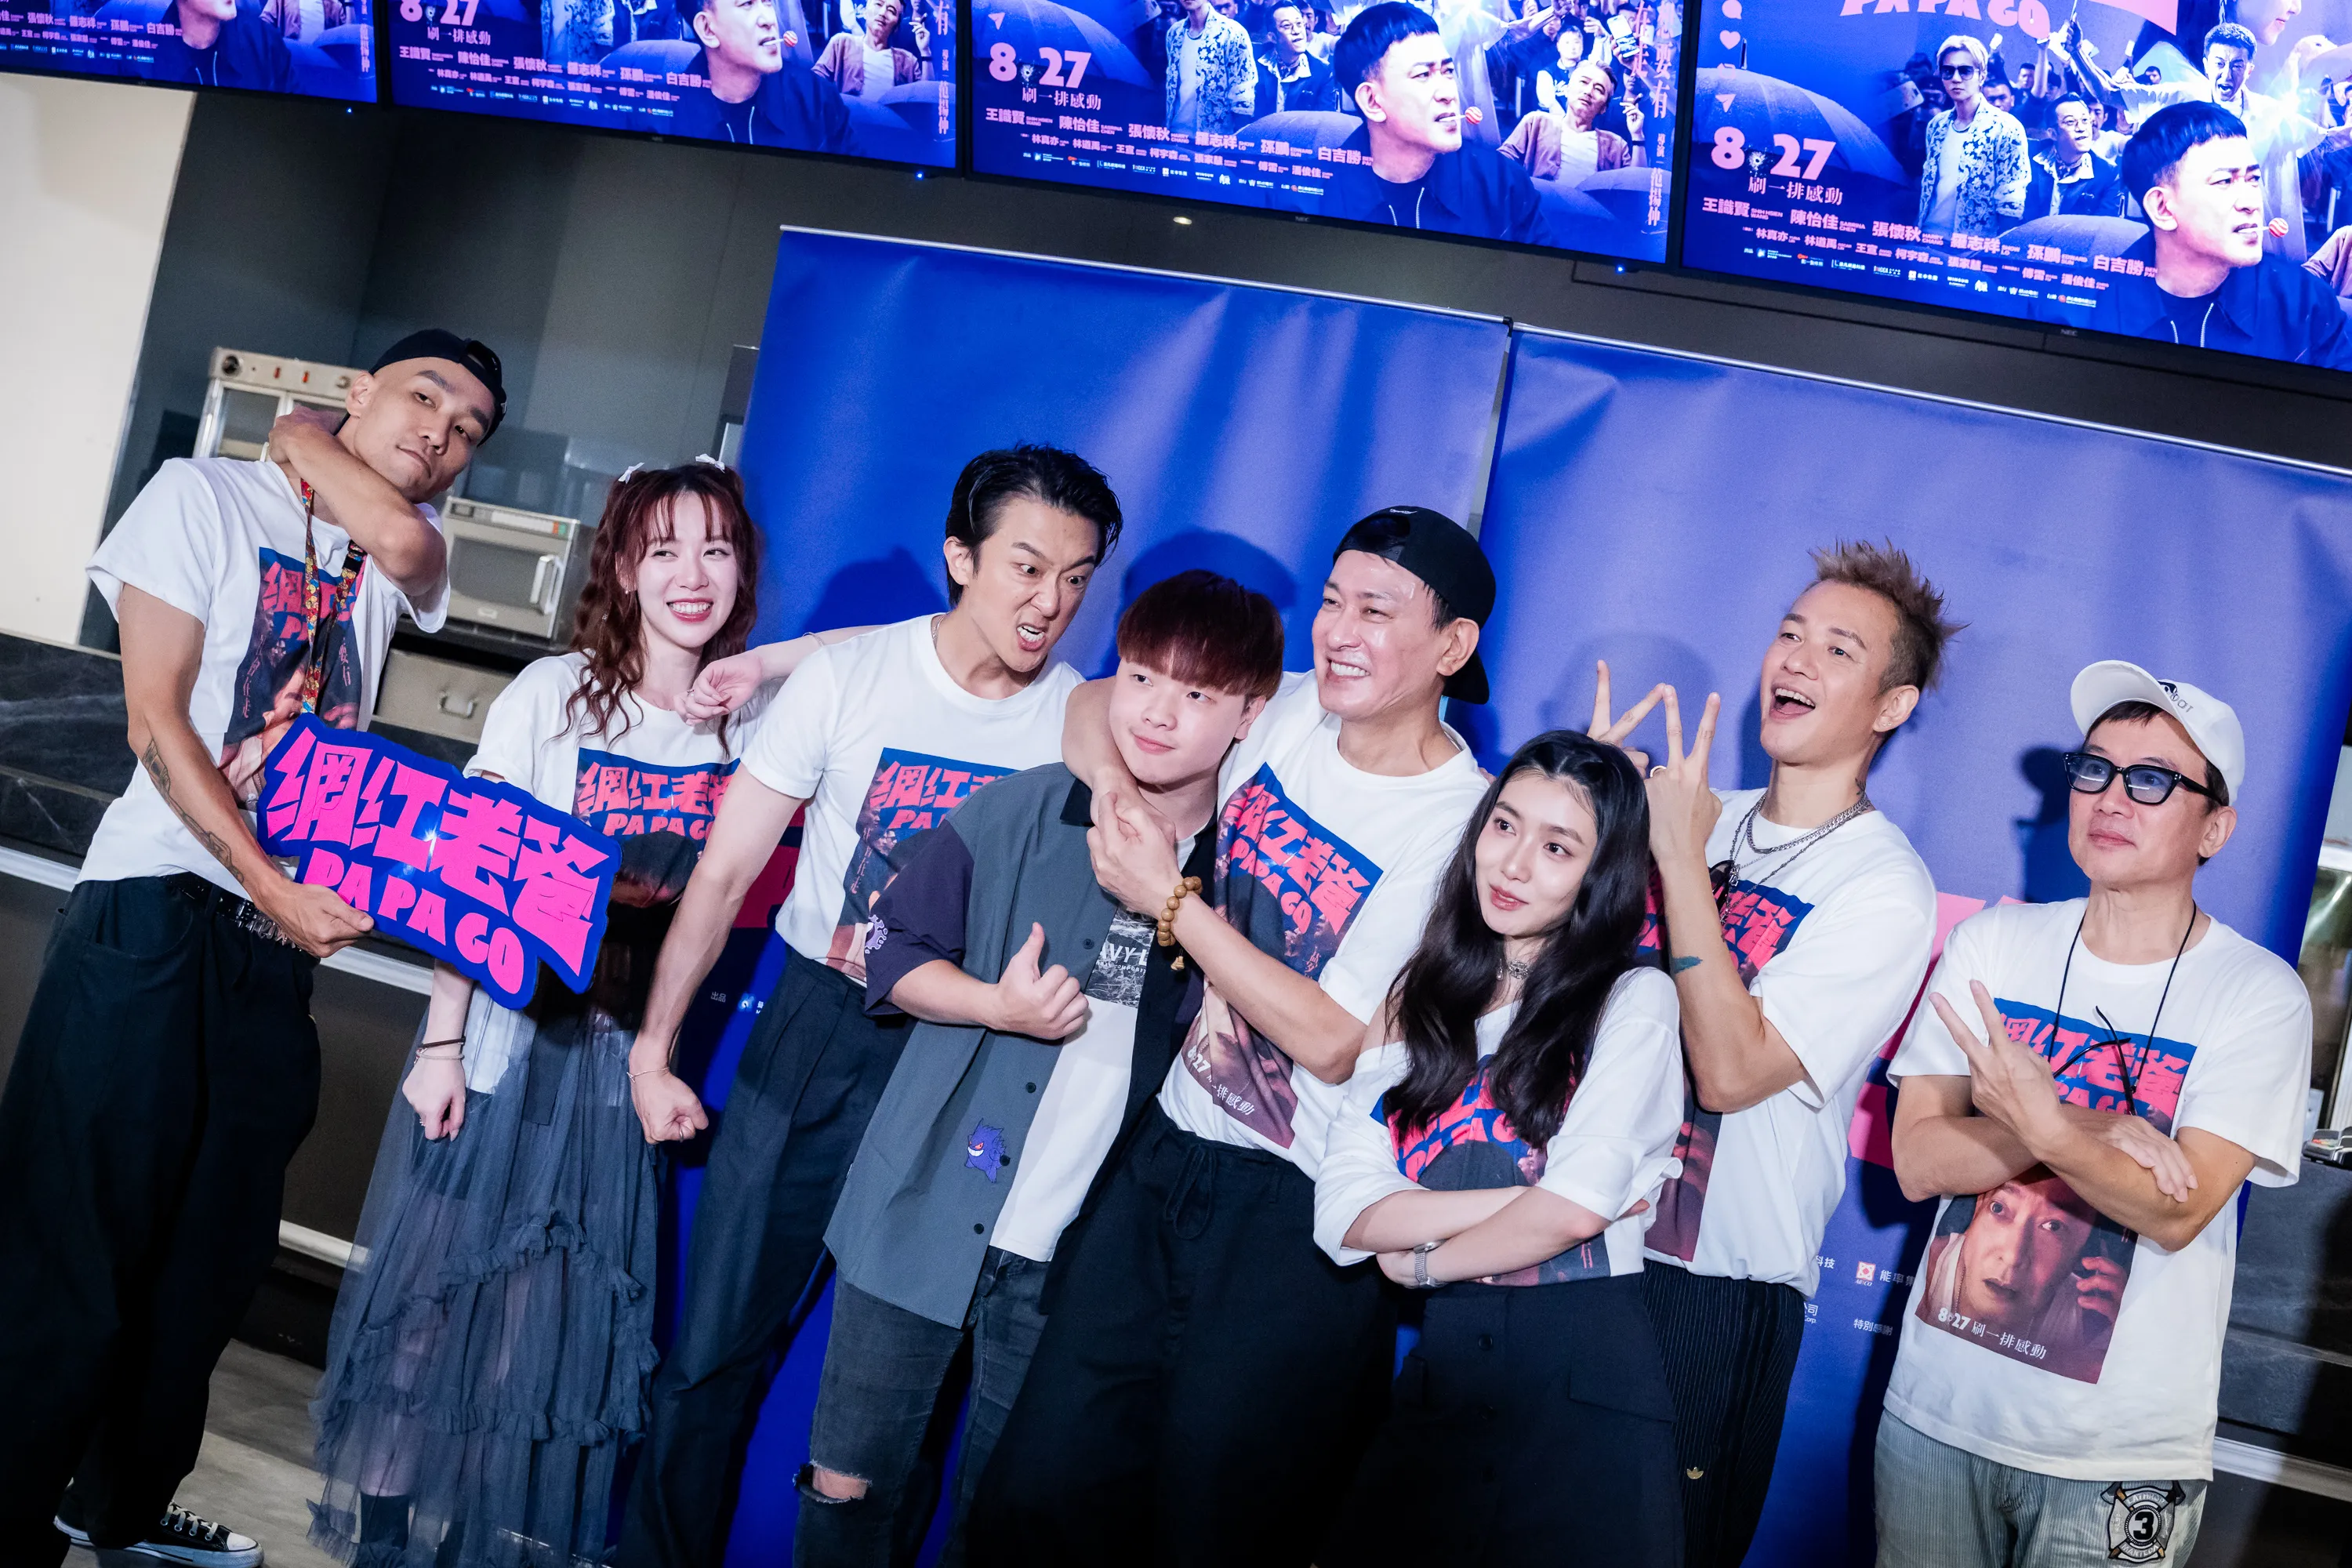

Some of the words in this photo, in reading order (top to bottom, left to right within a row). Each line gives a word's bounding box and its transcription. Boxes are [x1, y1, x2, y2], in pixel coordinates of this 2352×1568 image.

[1039, 47, 1091, 89] 27
[1022, 88, 1102, 111] 刷一排感動
[1059, 115, 1100, 133] 陳怡佳
[1128, 123, 1170, 141] 張懷秋
[1318, 146, 1361, 165] 白吉勝
[1770, 133, 1836, 180] 27
[1748, 176, 1843, 205] 刷一排感動
[1702, 197, 1750, 217] 王識賢
[1790, 209, 1838, 230] 陳怡佳
[1872, 220, 1922, 242] 張懷秋
[1950, 232, 2000, 254] 羅志祥
[2027, 244, 2061, 263] 孫鵬
[2093, 254, 2143, 276] 白吉勝
[870, 760, 1005, 808] 網紅
[267, 727, 609, 977] 網紅老爸
[710, 991, 726, 1003] 出品
[1853, 1318, 1893, 1336] 特別感謝
[1971, 1319, 2047, 1360] 刷一排感動
[2132, 1511, 2154, 1541] 3
